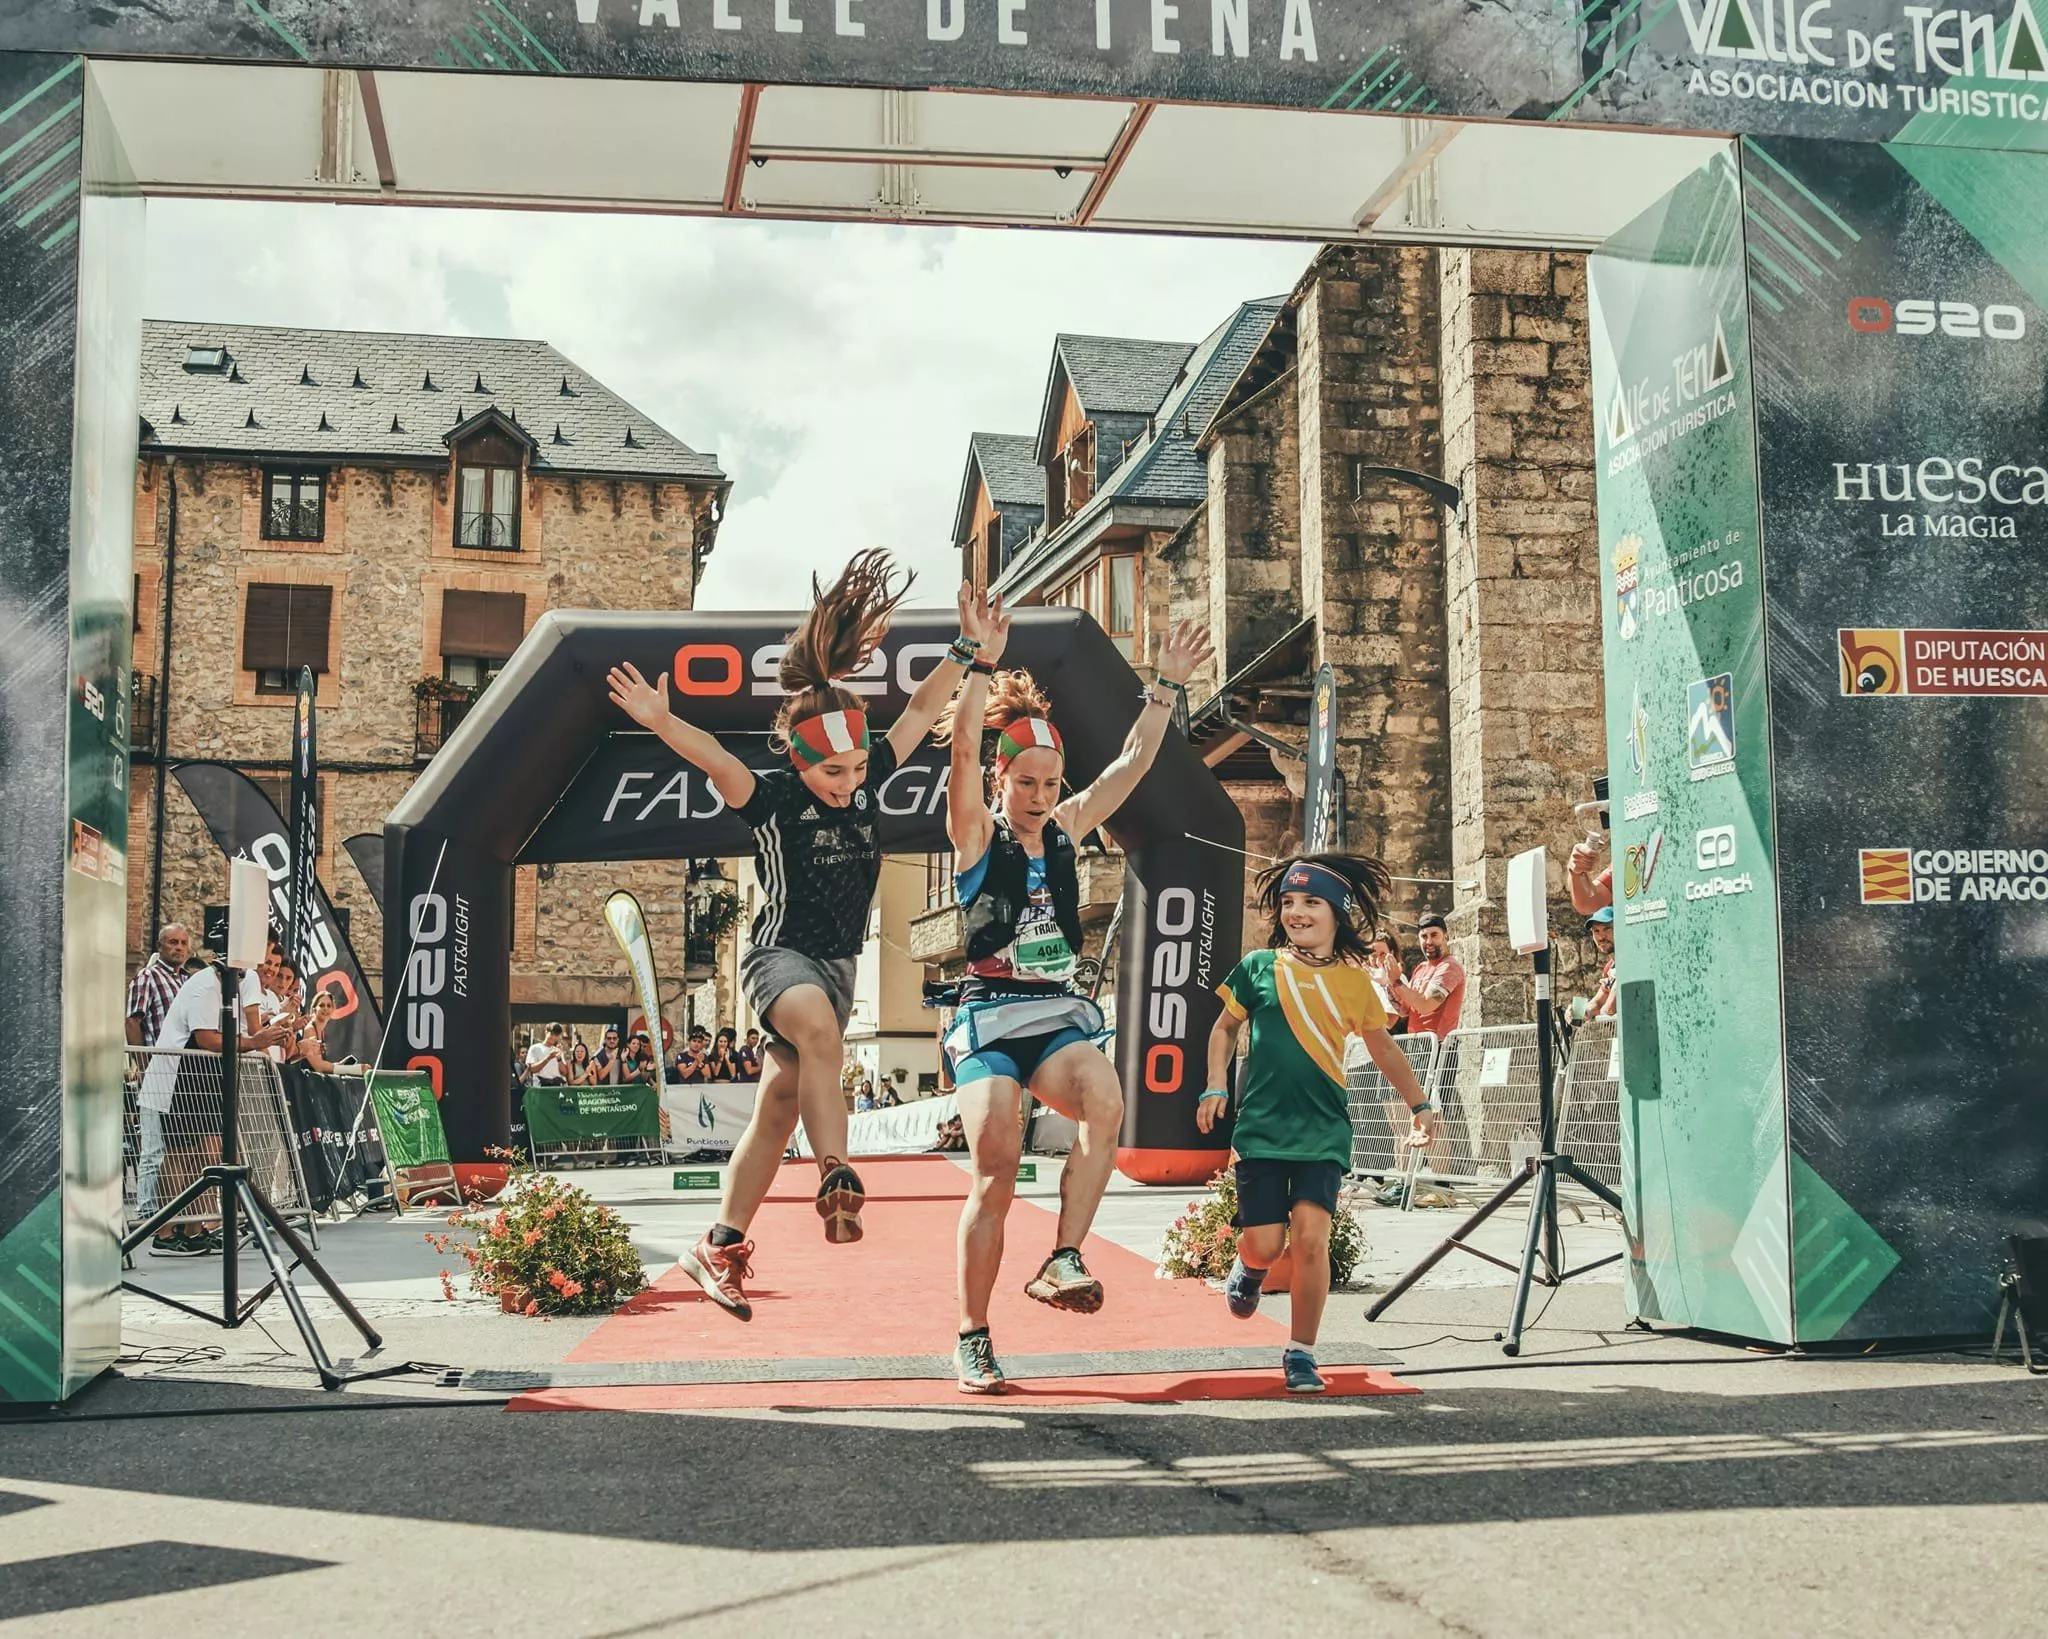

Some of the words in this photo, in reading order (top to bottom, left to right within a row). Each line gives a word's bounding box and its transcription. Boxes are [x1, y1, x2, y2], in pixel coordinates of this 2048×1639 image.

[1680, 0, 1835, 66] VALLE
[1848, 29, 1895, 72] DE
[1687, 69, 1889, 110] ASOCIACION
[1607, 425, 1669, 480] ASOCIACION
[1670, 391, 1737, 442] TURISTICA
[1643, 538, 1720, 581] Ayuntamiento
[1725, 530, 1740, 546] de
[1644, 559, 1743, 621] Panticosa
[1914, 636, 2046, 661] DIPUTACIÓN
[1916, 668, 1948, 687] DE
[1952, 668, 2048, 688] HUESCA
[1912, 850, 2048, 874] GOBIERNO
[1915, 878, 1951, 901] DE
[453, 893, 471, 998] FAST&LIGHT
[1034, 921, 1058, 936] TRAIL
[1197, 888, 1217, 990] FAST&LIGHT
[579, 1107, 590, 1115] DE
[592, 1104, 638, 1114] MONTAÑISMO
